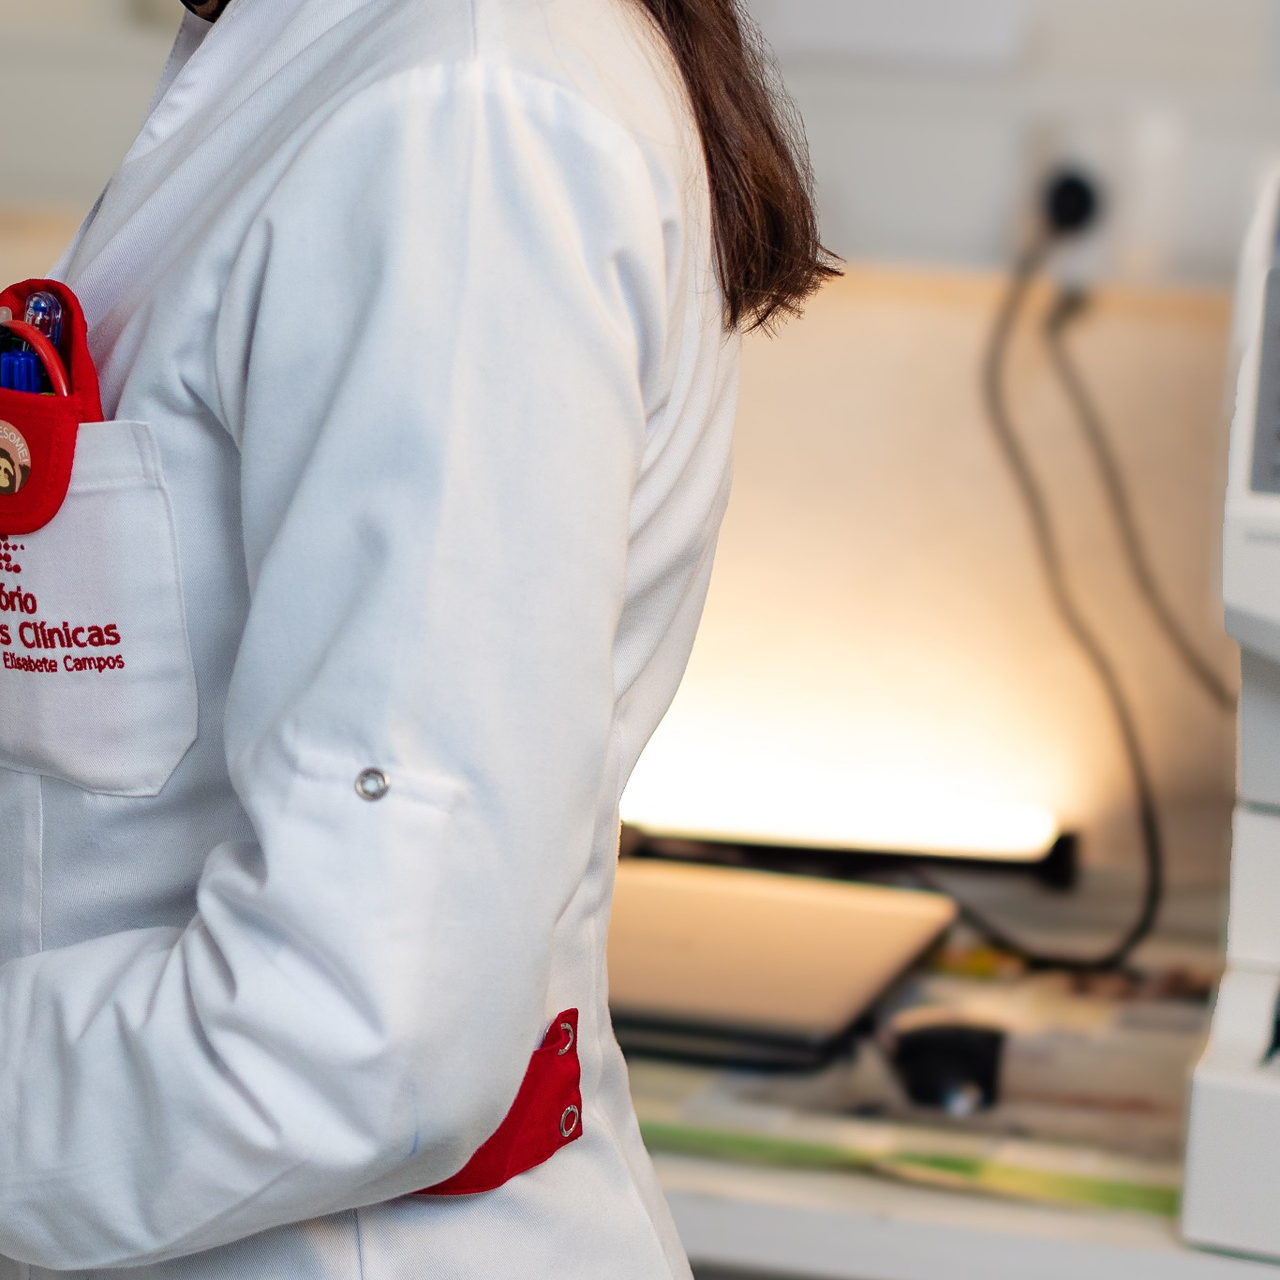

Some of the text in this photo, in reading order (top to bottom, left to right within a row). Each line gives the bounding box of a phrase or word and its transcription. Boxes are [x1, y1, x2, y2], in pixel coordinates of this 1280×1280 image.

[19, 620, 122, 650] Clínicas
[3, 651, 59, 673] Elisabete
[63, 654, 125, 673] Campos
